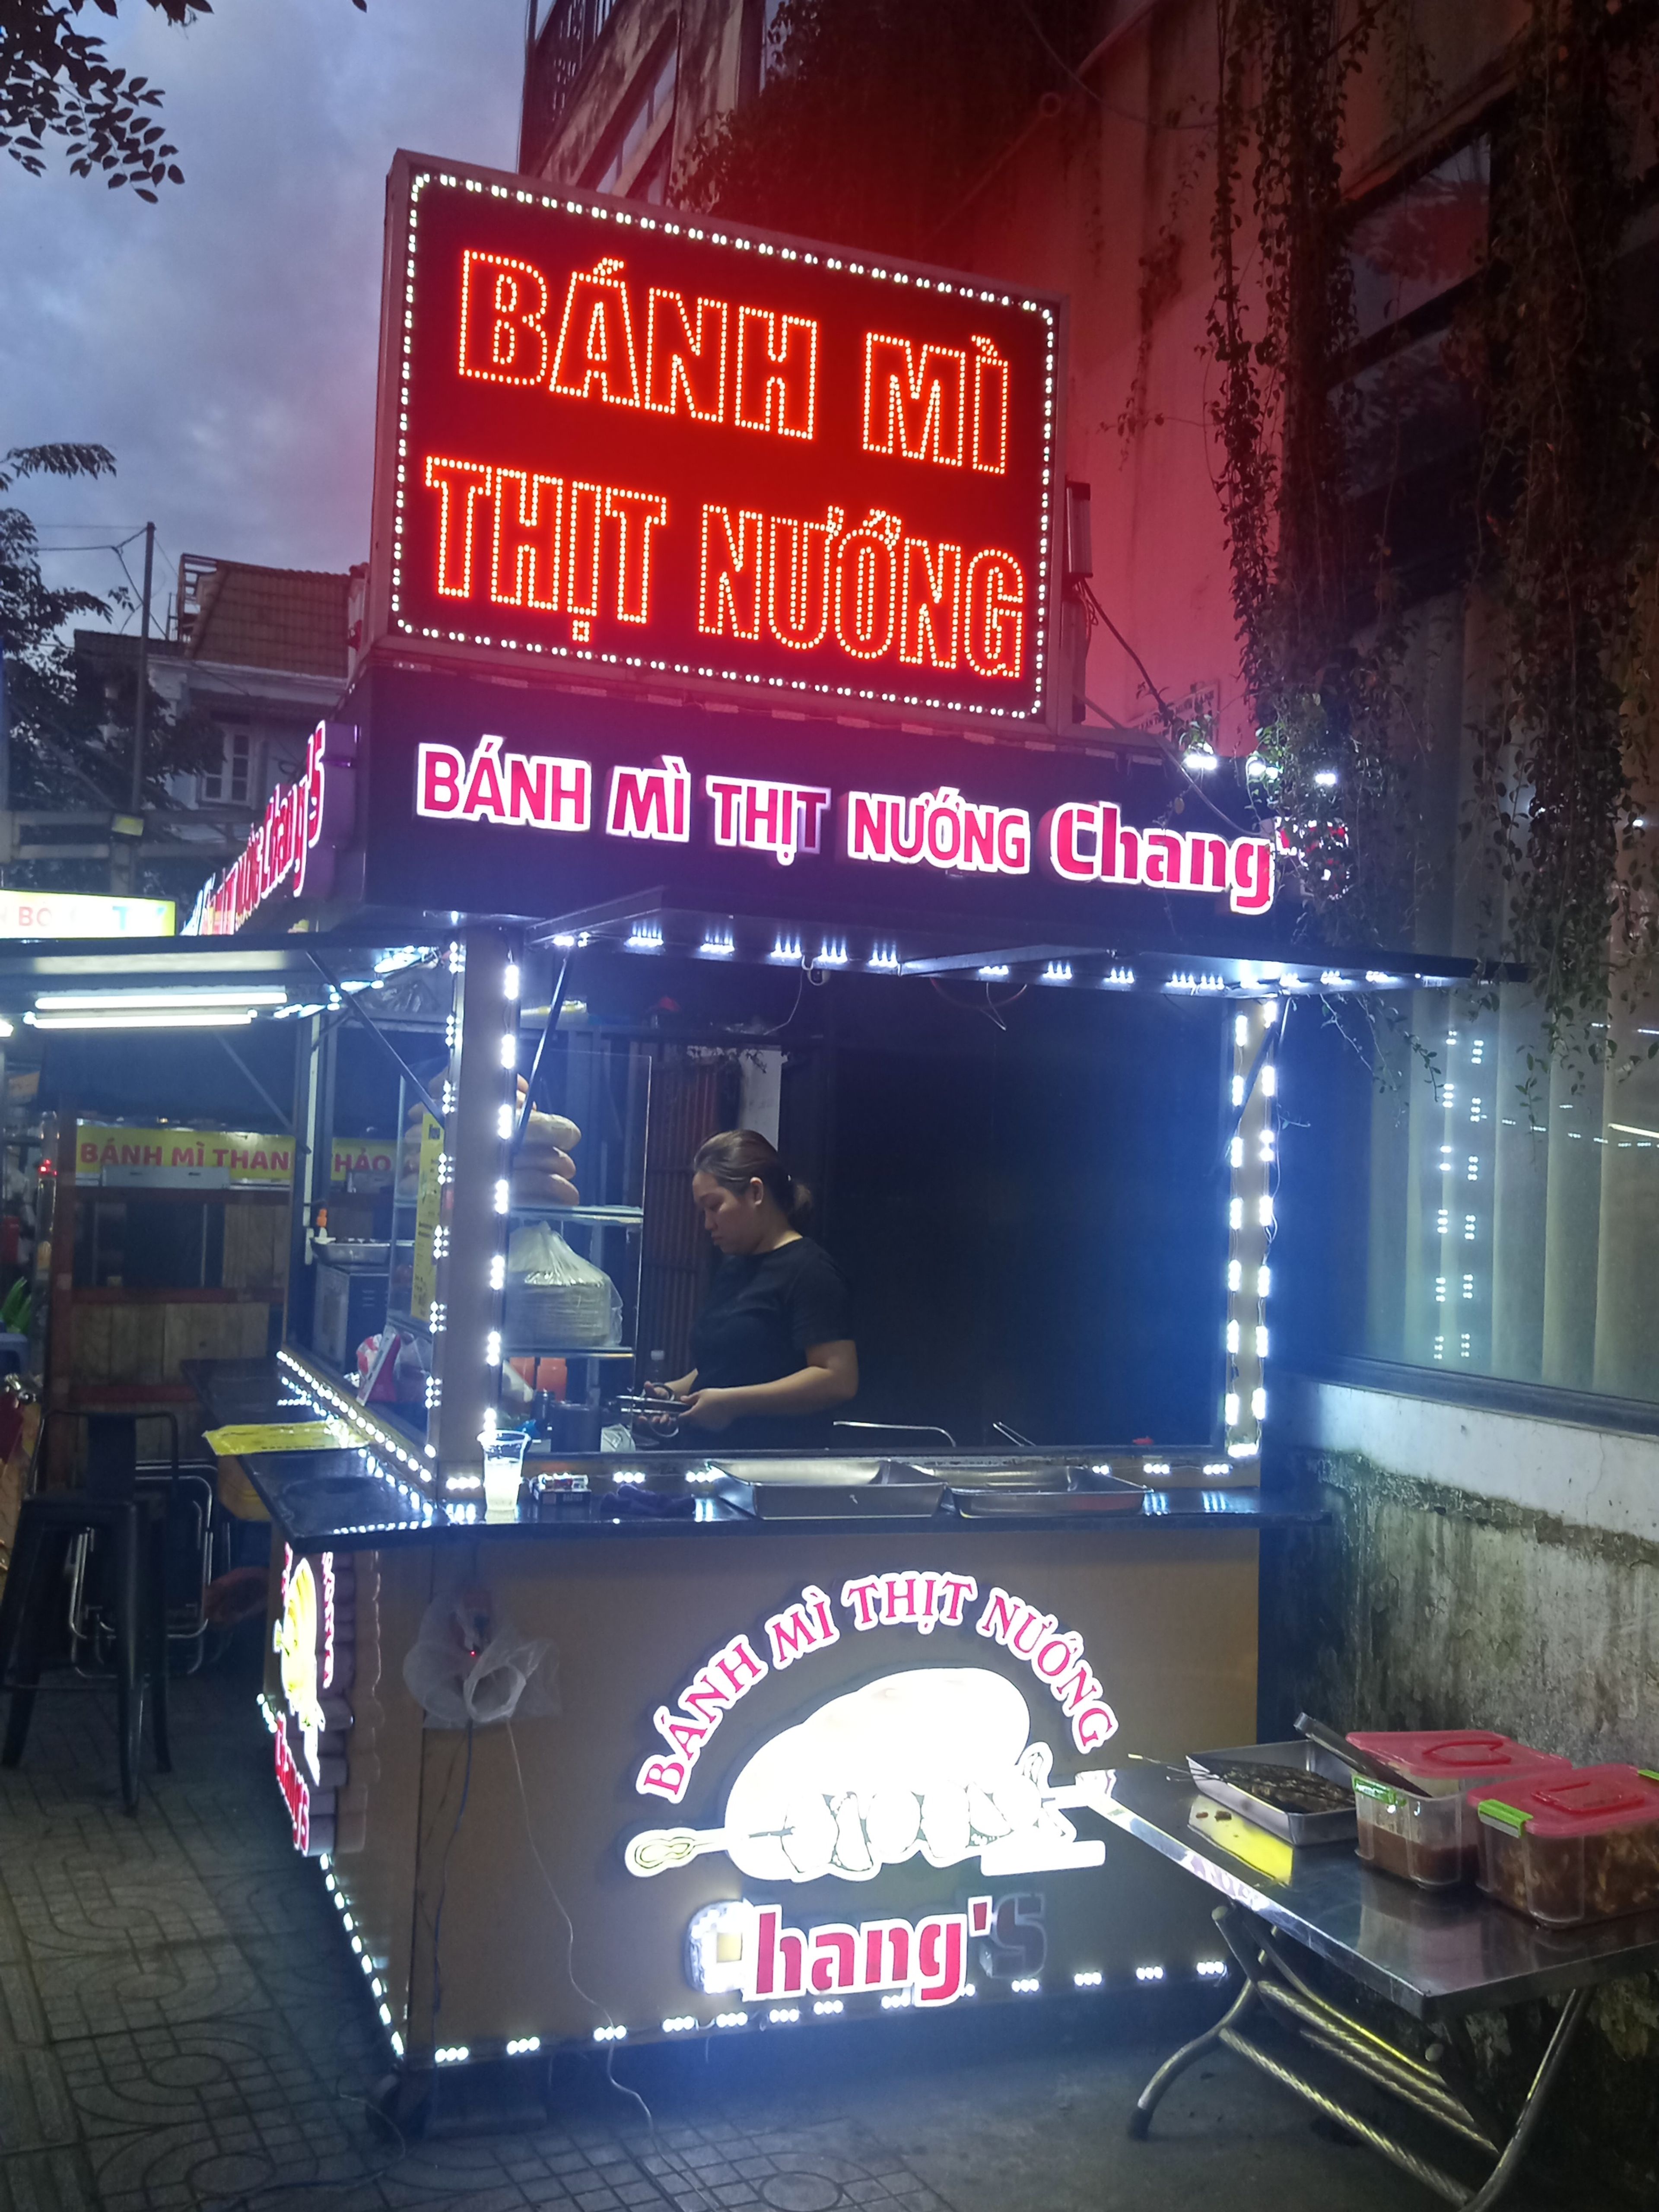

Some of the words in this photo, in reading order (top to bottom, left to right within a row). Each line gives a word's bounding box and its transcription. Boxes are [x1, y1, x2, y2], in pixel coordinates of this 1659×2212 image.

[460, 250, 817, 440] BÁNH
[864, 334, 1008, 474] MÌ
[425, 456, 667, 642] THỊT
[698, 503, 1023, 678] NƯỚNG
[417, 734, 591, 831] BÁNH
[606, 755, 690, 842] MÌ
[707, 775, 831, 865] THỊT
[848, 786, 1030, 874] NƯỚNG
[81, 1138, 162, 1166] BÁNH
[172, 1141, 205, 1166] MÌ
[212, 1149, 289, 1171] THAN
[334, 1147, 391, 1173] HẢO
[637, 1635, 768, 1803] BÁNH
[765, 1586, 839, 1669] MÌ
[841, 1571, 978, 1634] THỊT
[976, 1587, 1118, 1754] NƯỚNG
